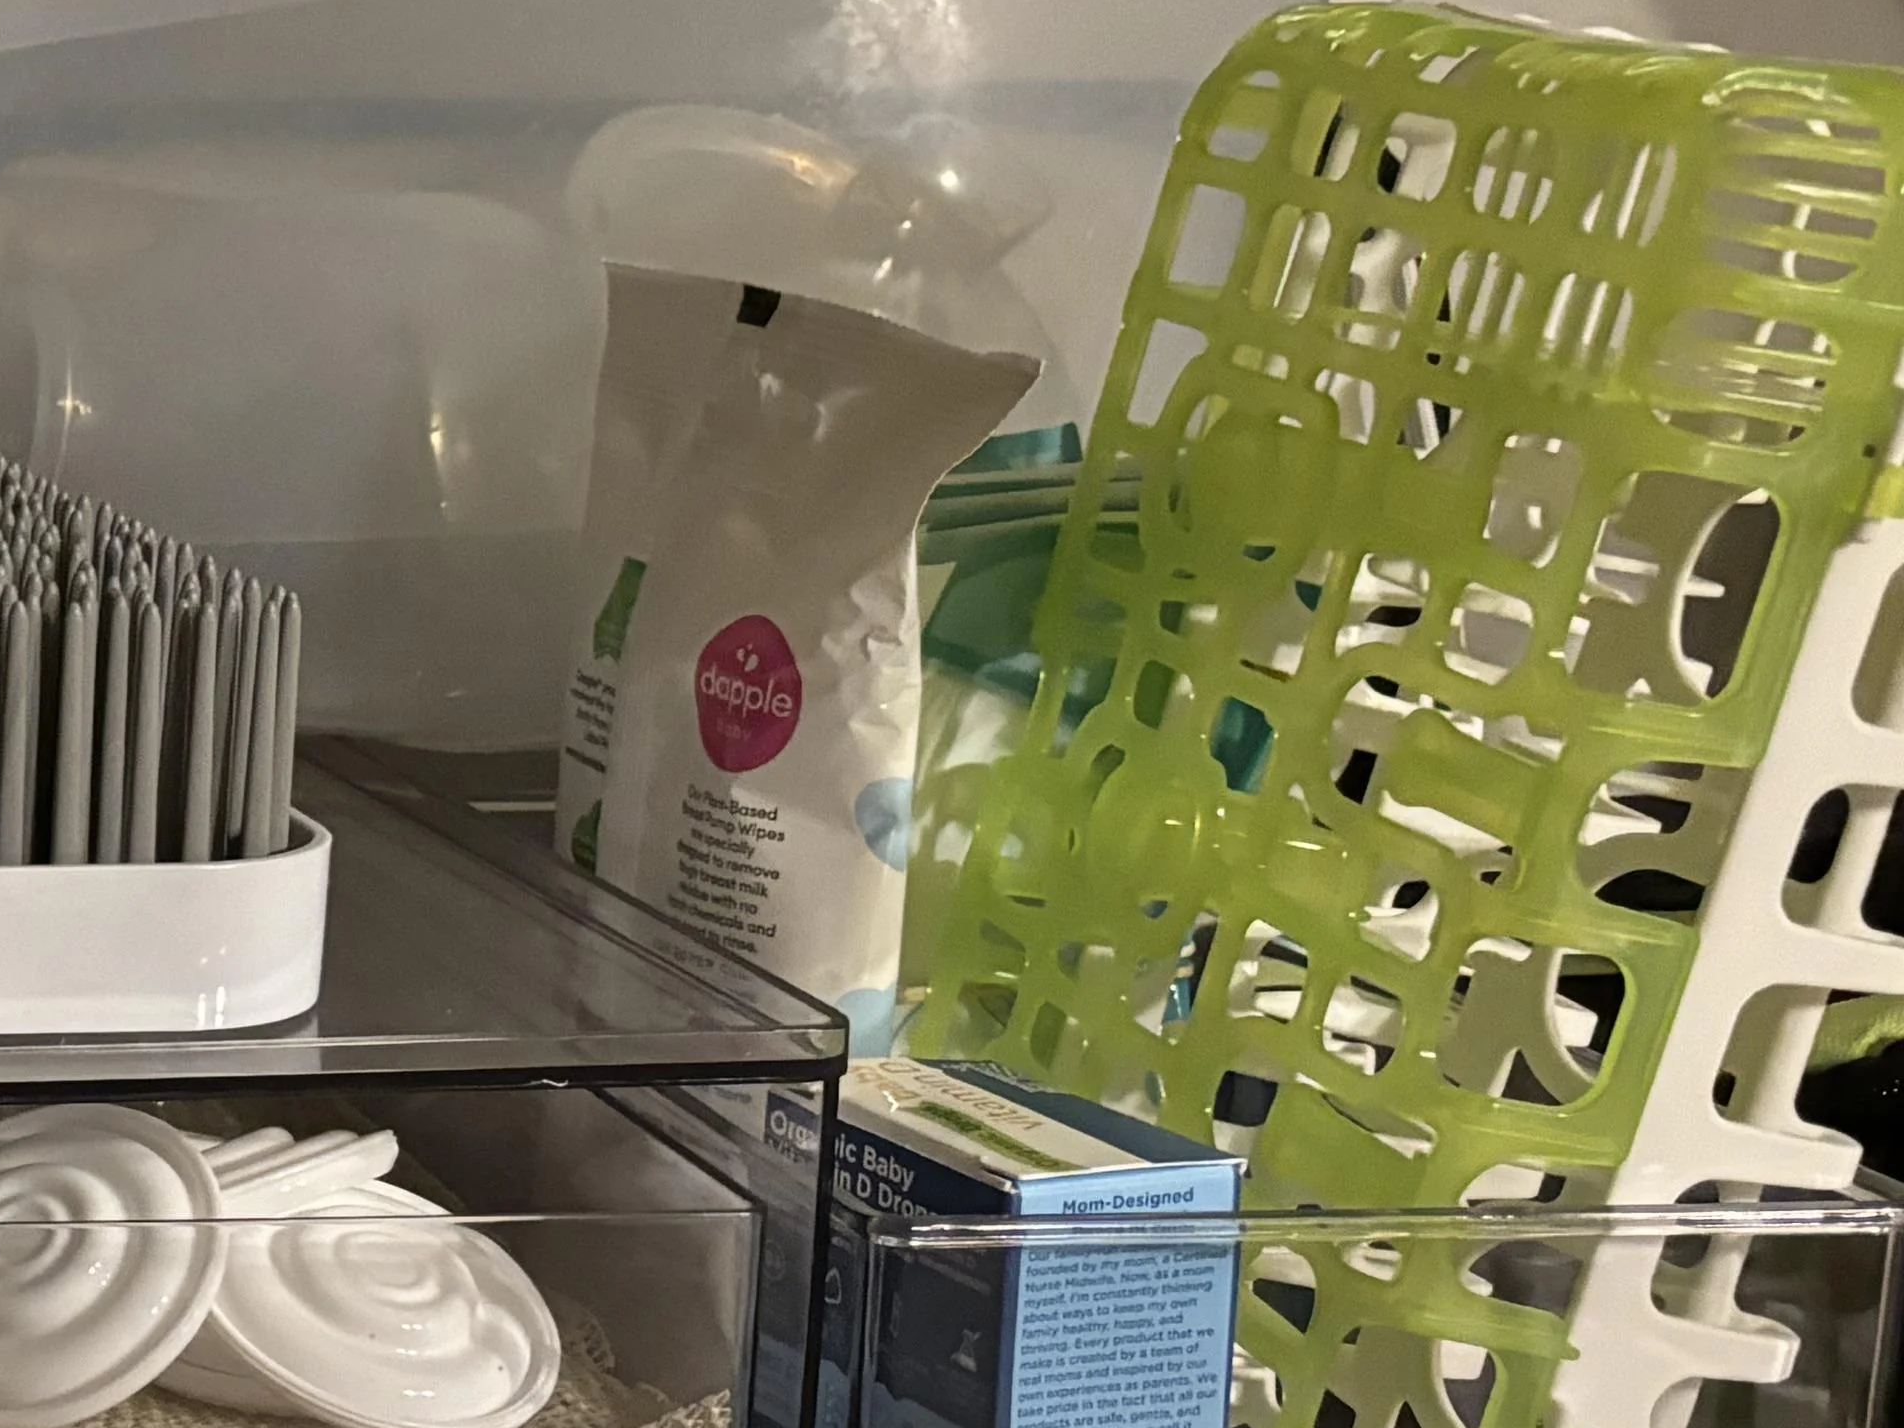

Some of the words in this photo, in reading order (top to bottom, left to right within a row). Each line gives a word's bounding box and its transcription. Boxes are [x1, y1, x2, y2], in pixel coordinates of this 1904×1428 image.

[701, 662, 792, 717] dapple
[739, 821, 785, 842] Wipes
[726, 859, 780, 880] remove
[739, 881, 768, 898] milk
[740, 901, 758, 915] no
[748, 923, 776, 938] and
[862, 1143, 915, 1193] Baby
[856, 1177, 872, 1199] D
[877, 1181, 939, 1217] Drop
[1063, 1187, 1194, 1214] Mom-Designed
[1025, 1280, 1061, 1293] Nurse
[1155, 1270, 1168, 1280] as
[1171, 1270, 1179, 1278] a
[1183, 1265, 1215, 1277] mom
[1026, 1262, 1079, 1277] founded
[1082, 1261, 1096, 1273] by
[1101, 1259, 1120, 1270] my
[1162, 1255, 1170, 1263] a
[1093, 1285, 1158, 1302] constantly
[1024, 1311, 1058, 1324] about
[1063, 1309, 1093, 1321] ways
[1097, 1305, 1110, 1316] to
[1113, 1303, 1145, 1317] keep
[1148, 1300, 1167, 1312] my
[1170, 1297, 1198, 1309] own
[1022, 1327, 1060, 1341] family
[1159, 1313, 1184, 1326] and
[1075, 1338, 1109, 1352] Every
[1113, 1331, 1163, 1346] product
[1167, 1328, 1192, 1340] that
[1197, 1327, 1214, 1337] we
[1021, 1358, 1053, 1370] make
[1056, 1355, 1065, 1367] is
[1069, 1351, 1117, 1366] created
[1120, 1349, 1136, 1361] by
[1139, 1349, 1147, 1358] a
[1151, 1345, 1183, 1357] team
[1186, 1343, 1199, 1354] of
[1019, 1375, 1042, 1386] real
[1045, 1371, 1082, 1384] moms
[1086, 1367, 1109, 1379] and
[1112, 1362, 1164, 1378] inspired
[1167, 1359, 1183, 1372] by
[1186, 1359, 1207, 1370] our
[1018, 1391, 1043, 1403] own
[1046, 1382, 1121, 1400] experiences
[1124, 1381, 1138, 1392] as
[1197, 1373, 1217, 1384] We
[1018, 1405, 1043, 1418] take
[1046, 1401, 1079, 1416] pride
[1082, 1399, 1093, 1410] in
[1097, 1397, 1118, 1409] the
[1121, 1394, 1146, 1407] fact
[1150, 1391, 1175, 1404] that
[1178, 1389, 1193, 1402] all
[1196, 1389, 1217, 1399] our
[1074, 1415, 1093, 1426] are
[1098, 1412, 1126, 1424] safe,
[1177, 1405, 1201, 1417] and
